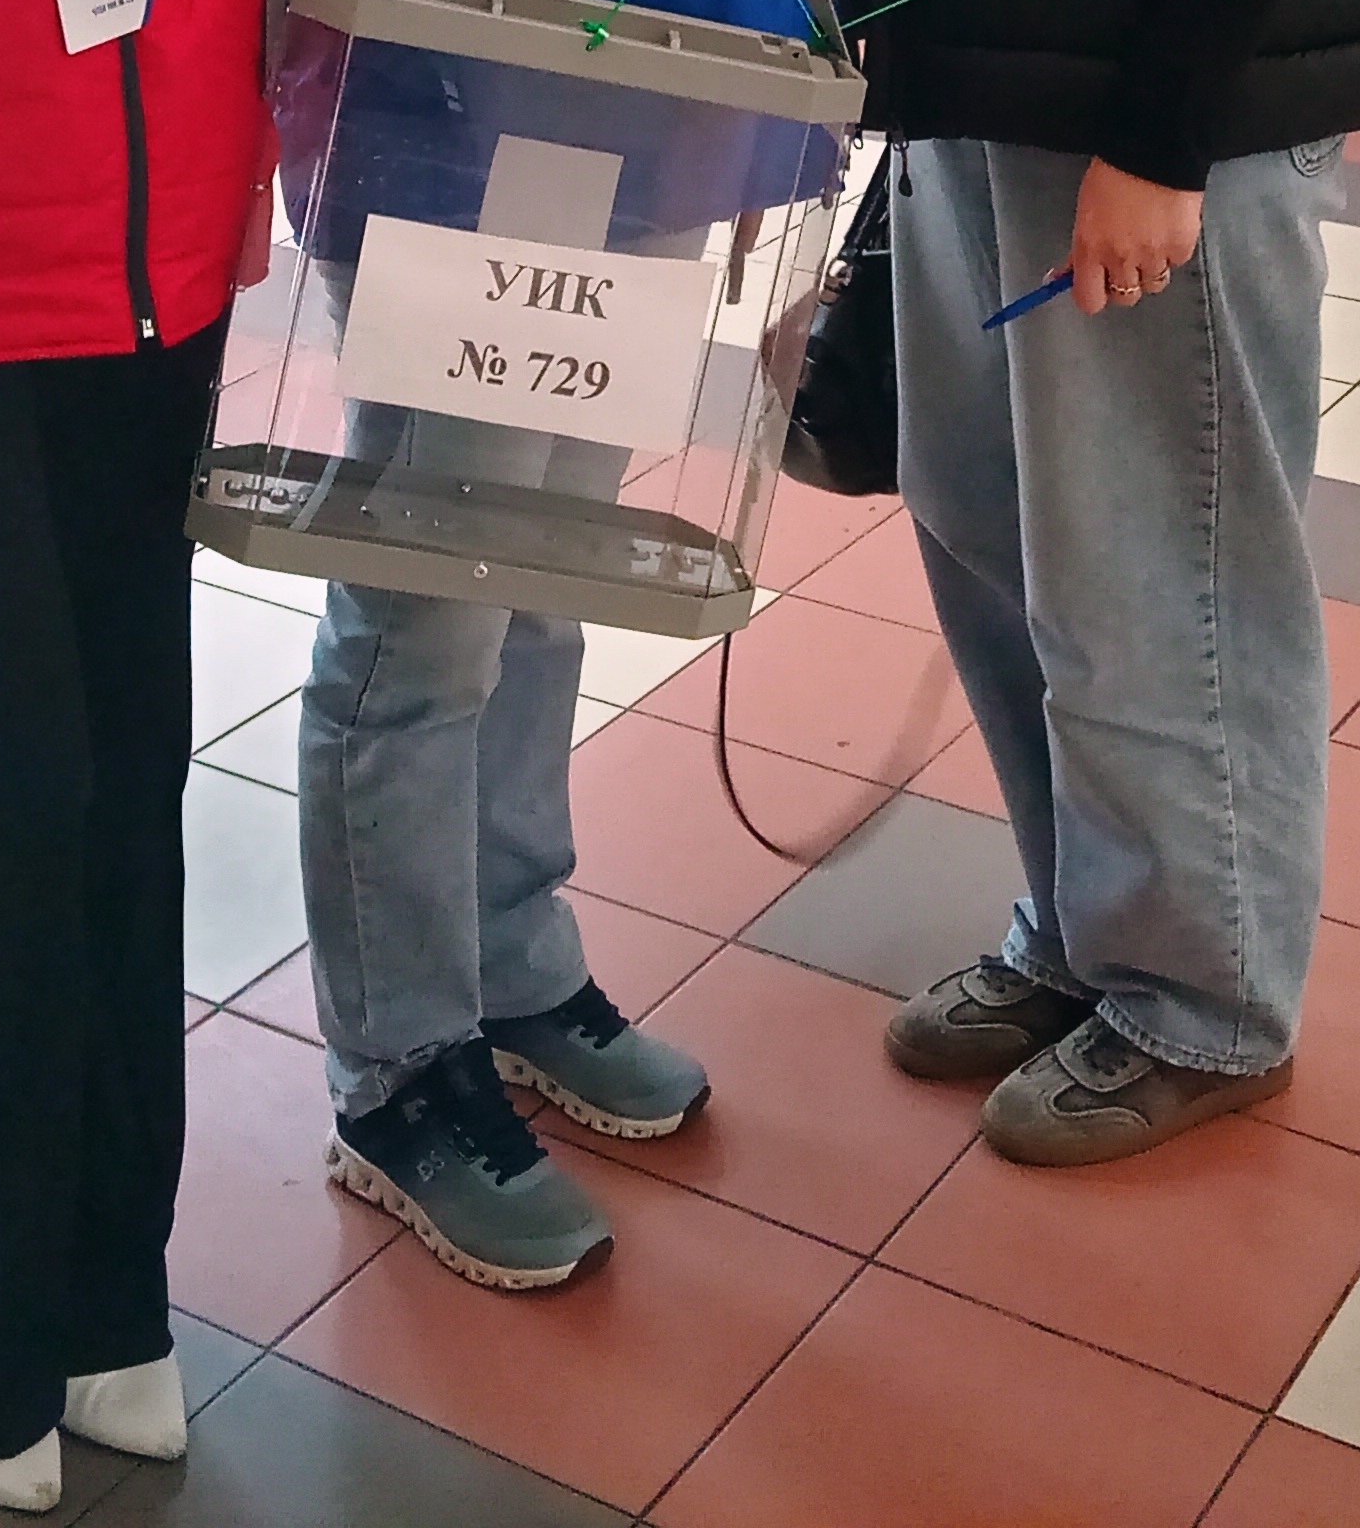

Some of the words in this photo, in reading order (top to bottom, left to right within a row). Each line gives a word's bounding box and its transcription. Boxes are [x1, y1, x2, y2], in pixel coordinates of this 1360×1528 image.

[485, 258, 614, 320] УИК
[446, 338, 508, 386] №
[527, 350, 611, 401] 729
